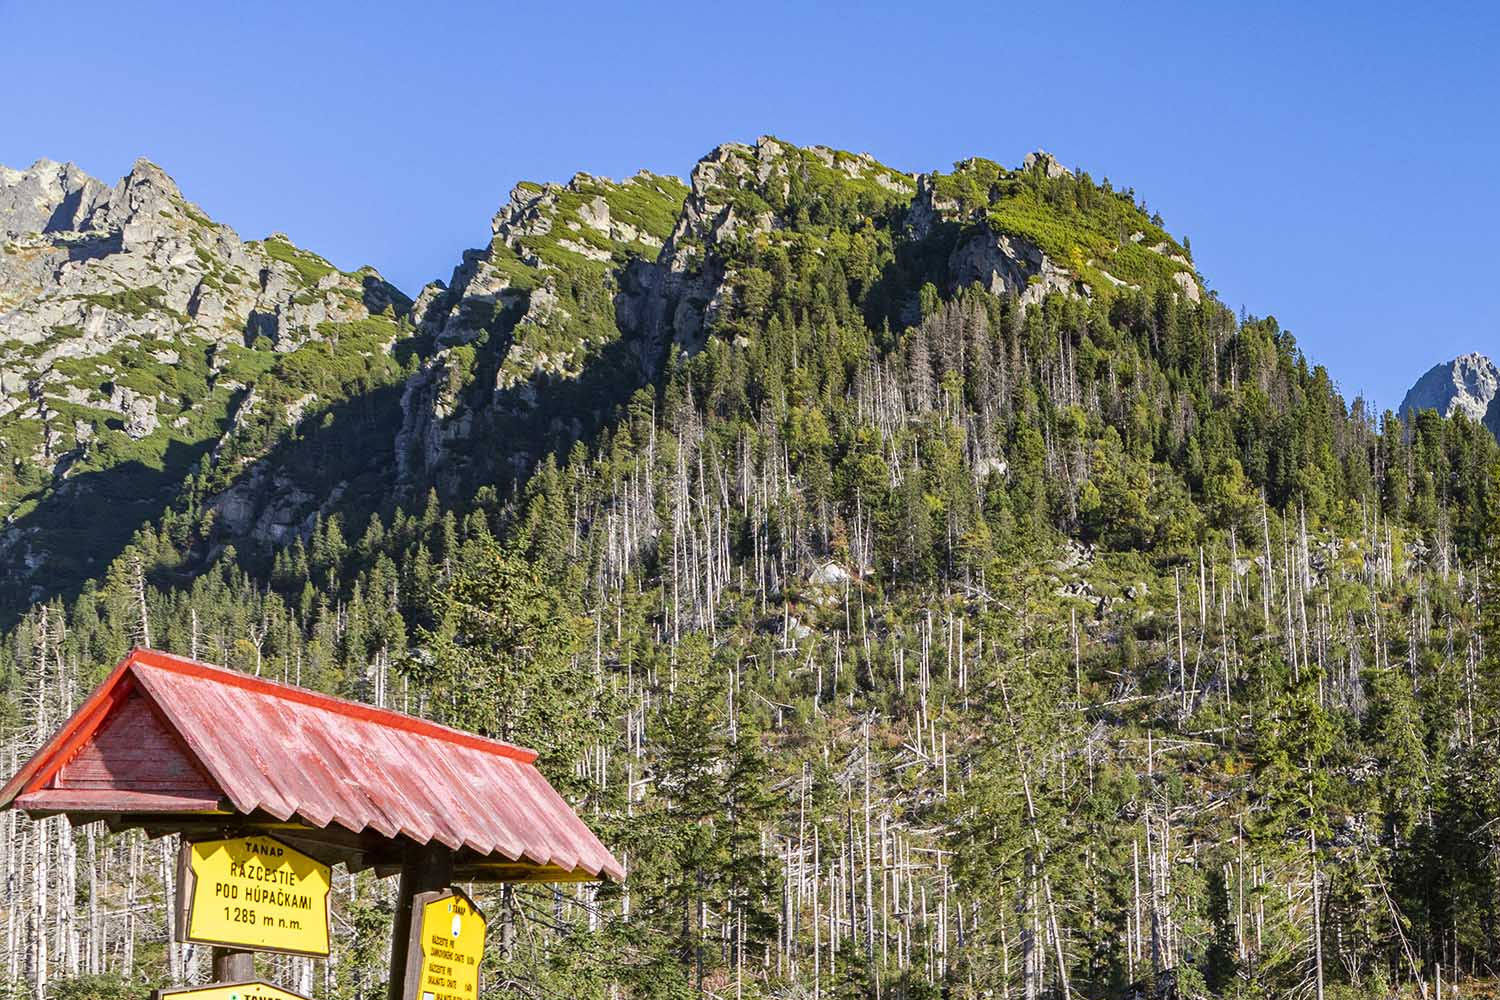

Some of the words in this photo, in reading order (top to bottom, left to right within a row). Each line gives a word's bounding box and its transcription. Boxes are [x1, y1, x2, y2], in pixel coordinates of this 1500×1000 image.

[245, 842, 284, 857] TANAP
[230, 860, 296, 886] RÁZCESTIE
[215, 882, 238, 899] POD
[245, 885, 312, 910] HÚPAČKAMI
